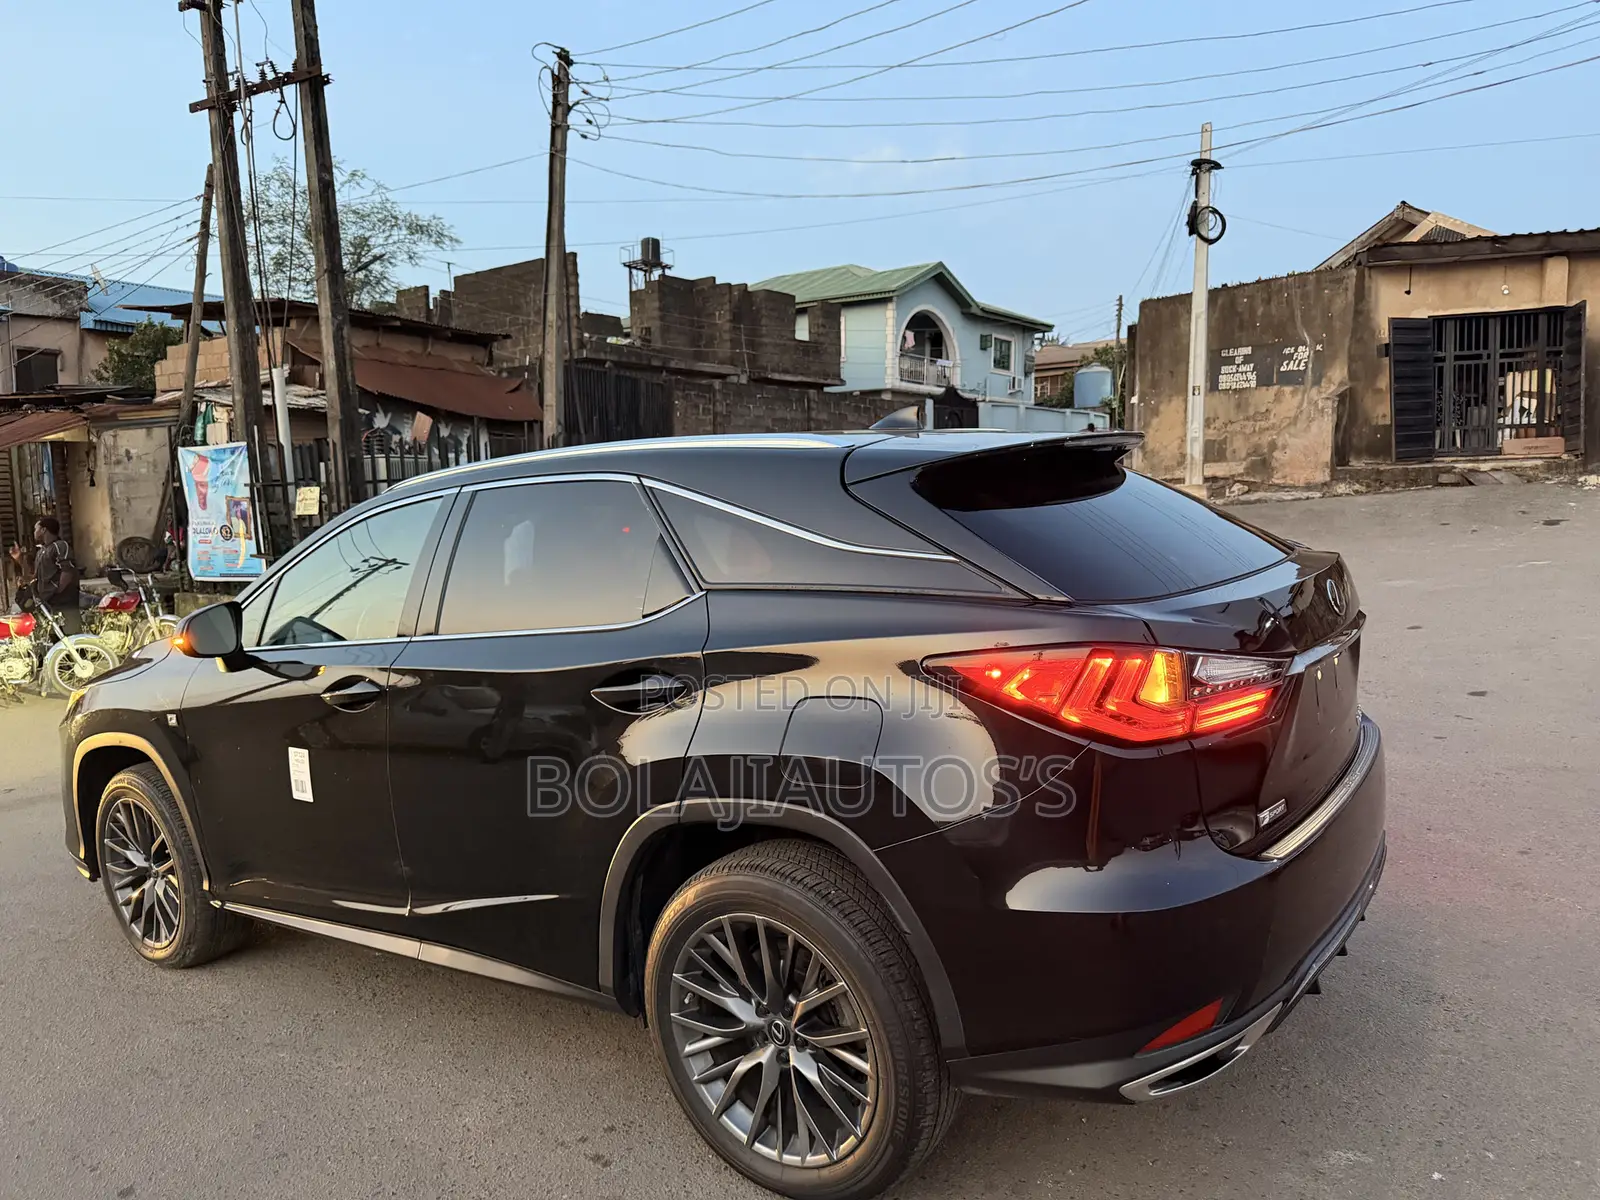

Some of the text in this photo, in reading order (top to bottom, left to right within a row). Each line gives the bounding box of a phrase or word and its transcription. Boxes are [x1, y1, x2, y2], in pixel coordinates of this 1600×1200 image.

[1235, 356, 1244, 364] OF
[1293, 352, 1309, 360] FOR
[1280, 359, 1309, 371] SALE
[1269, 804, 1285, 818] SPORT
